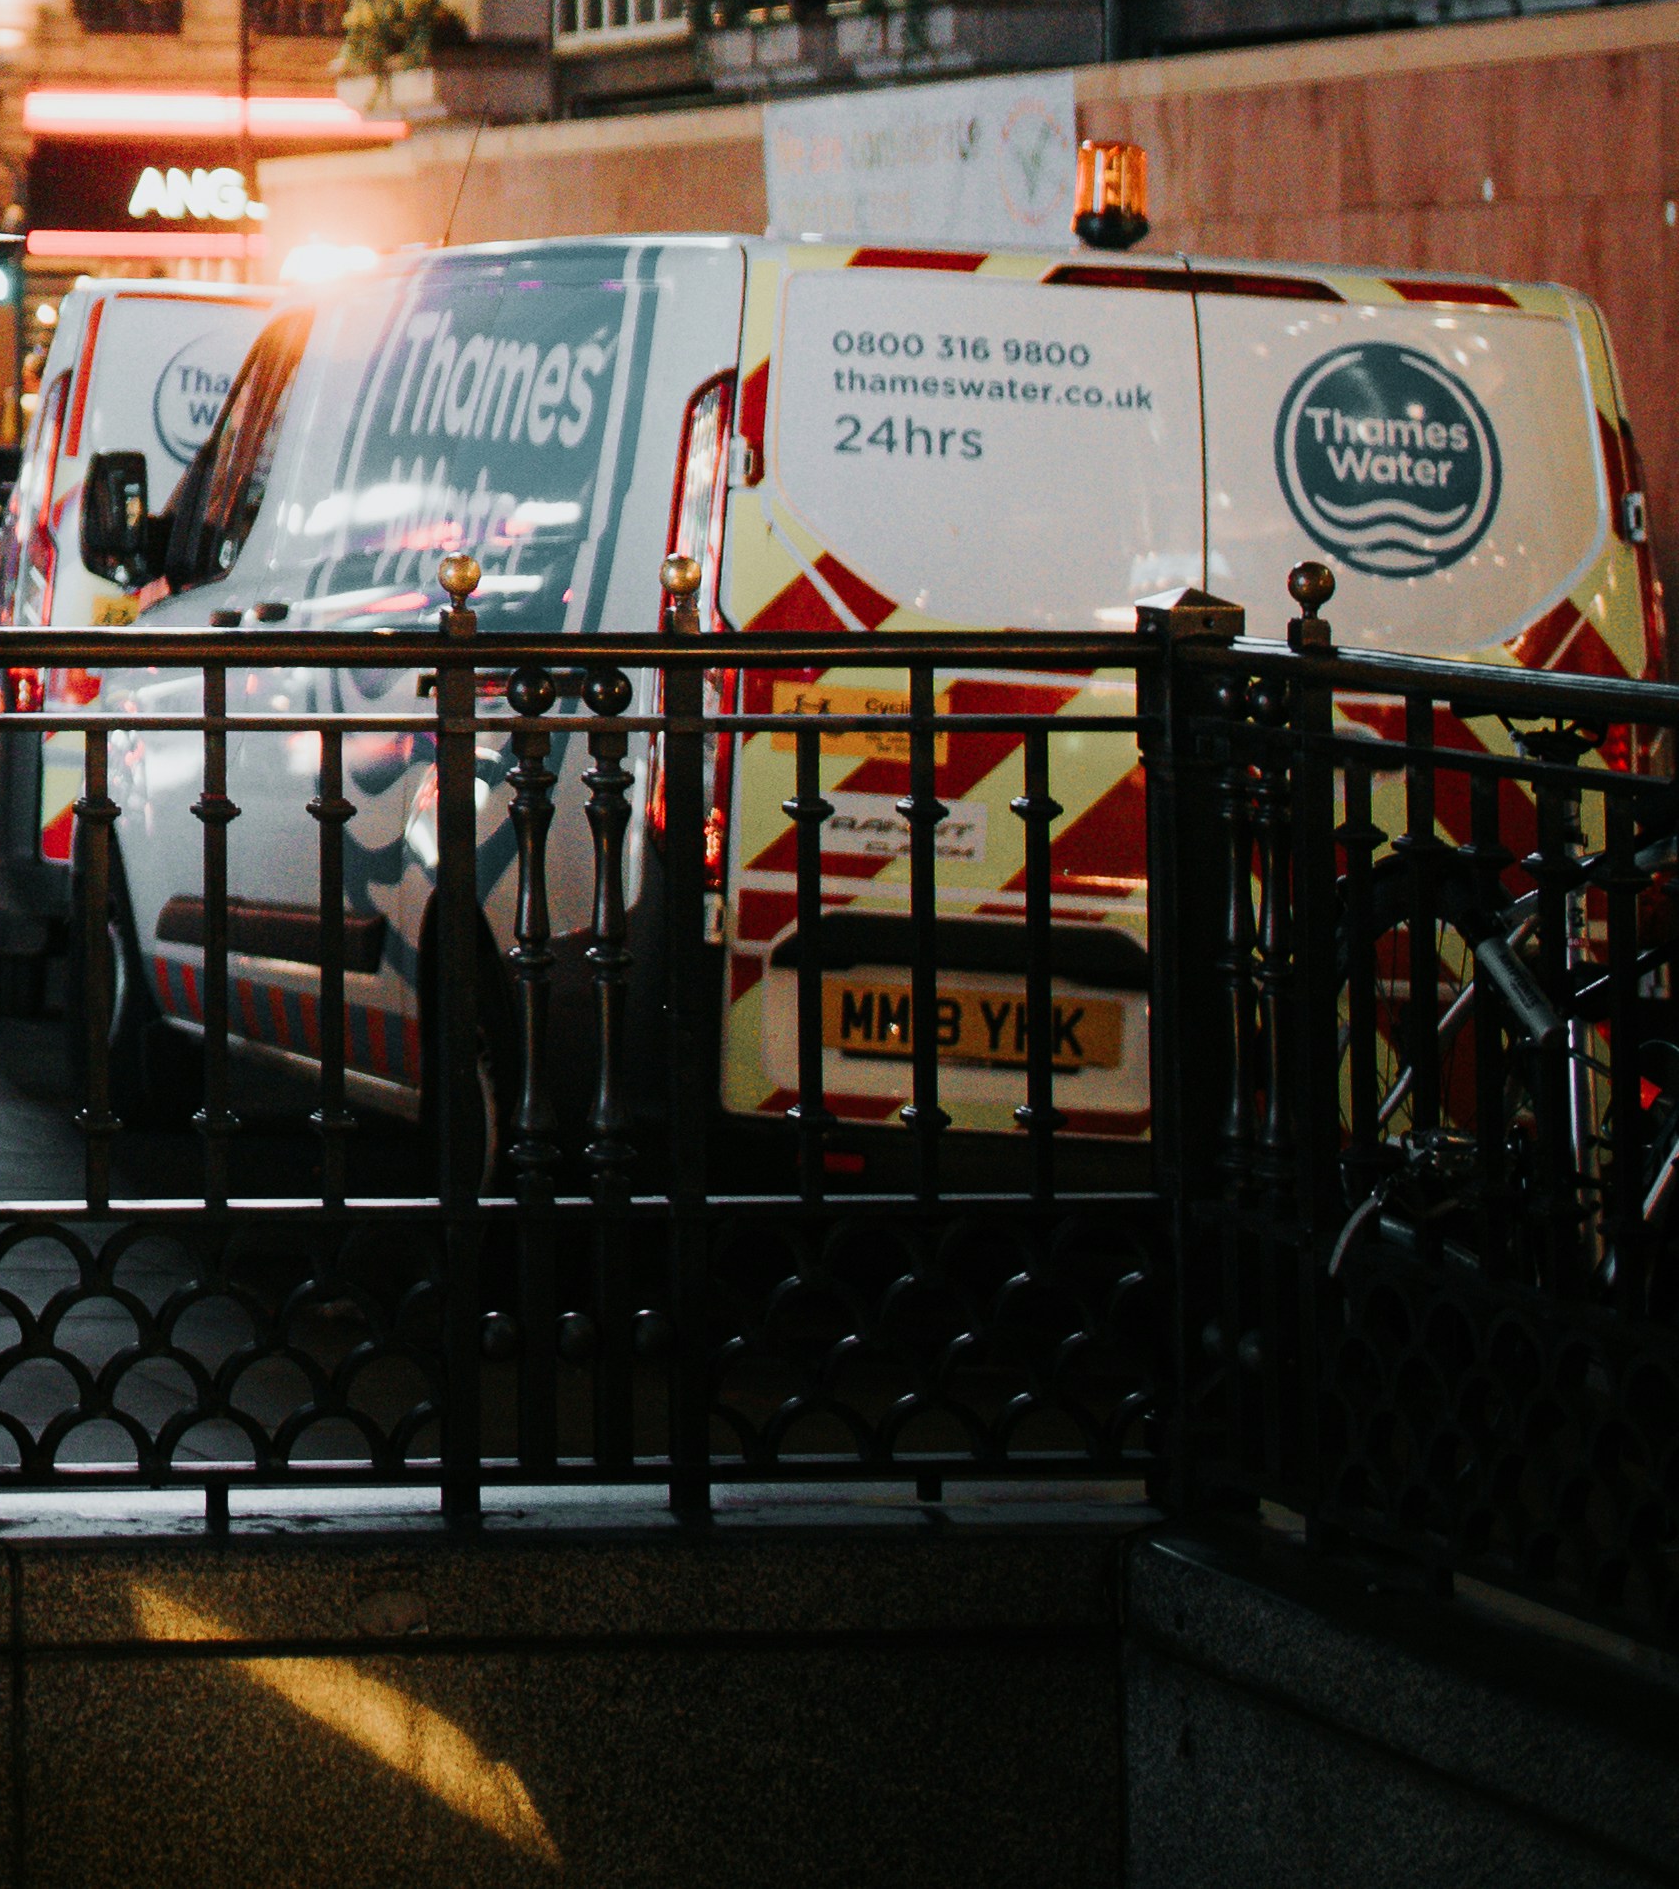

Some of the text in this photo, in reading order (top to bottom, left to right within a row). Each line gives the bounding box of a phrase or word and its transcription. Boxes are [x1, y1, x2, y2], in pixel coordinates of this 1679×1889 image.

[832, 331, 1091, 368] 0800 316 9800
[389, 309, 608, 449] Thames
[834, 369, 1153, 411] thameswater.co.uk
[835, 415, 983, 459] 24hrs
[1305, 407, 1469, 452] Thames
[1327, 446, 1453, 485] Water
[842, 989, 961, 1046] MM8
